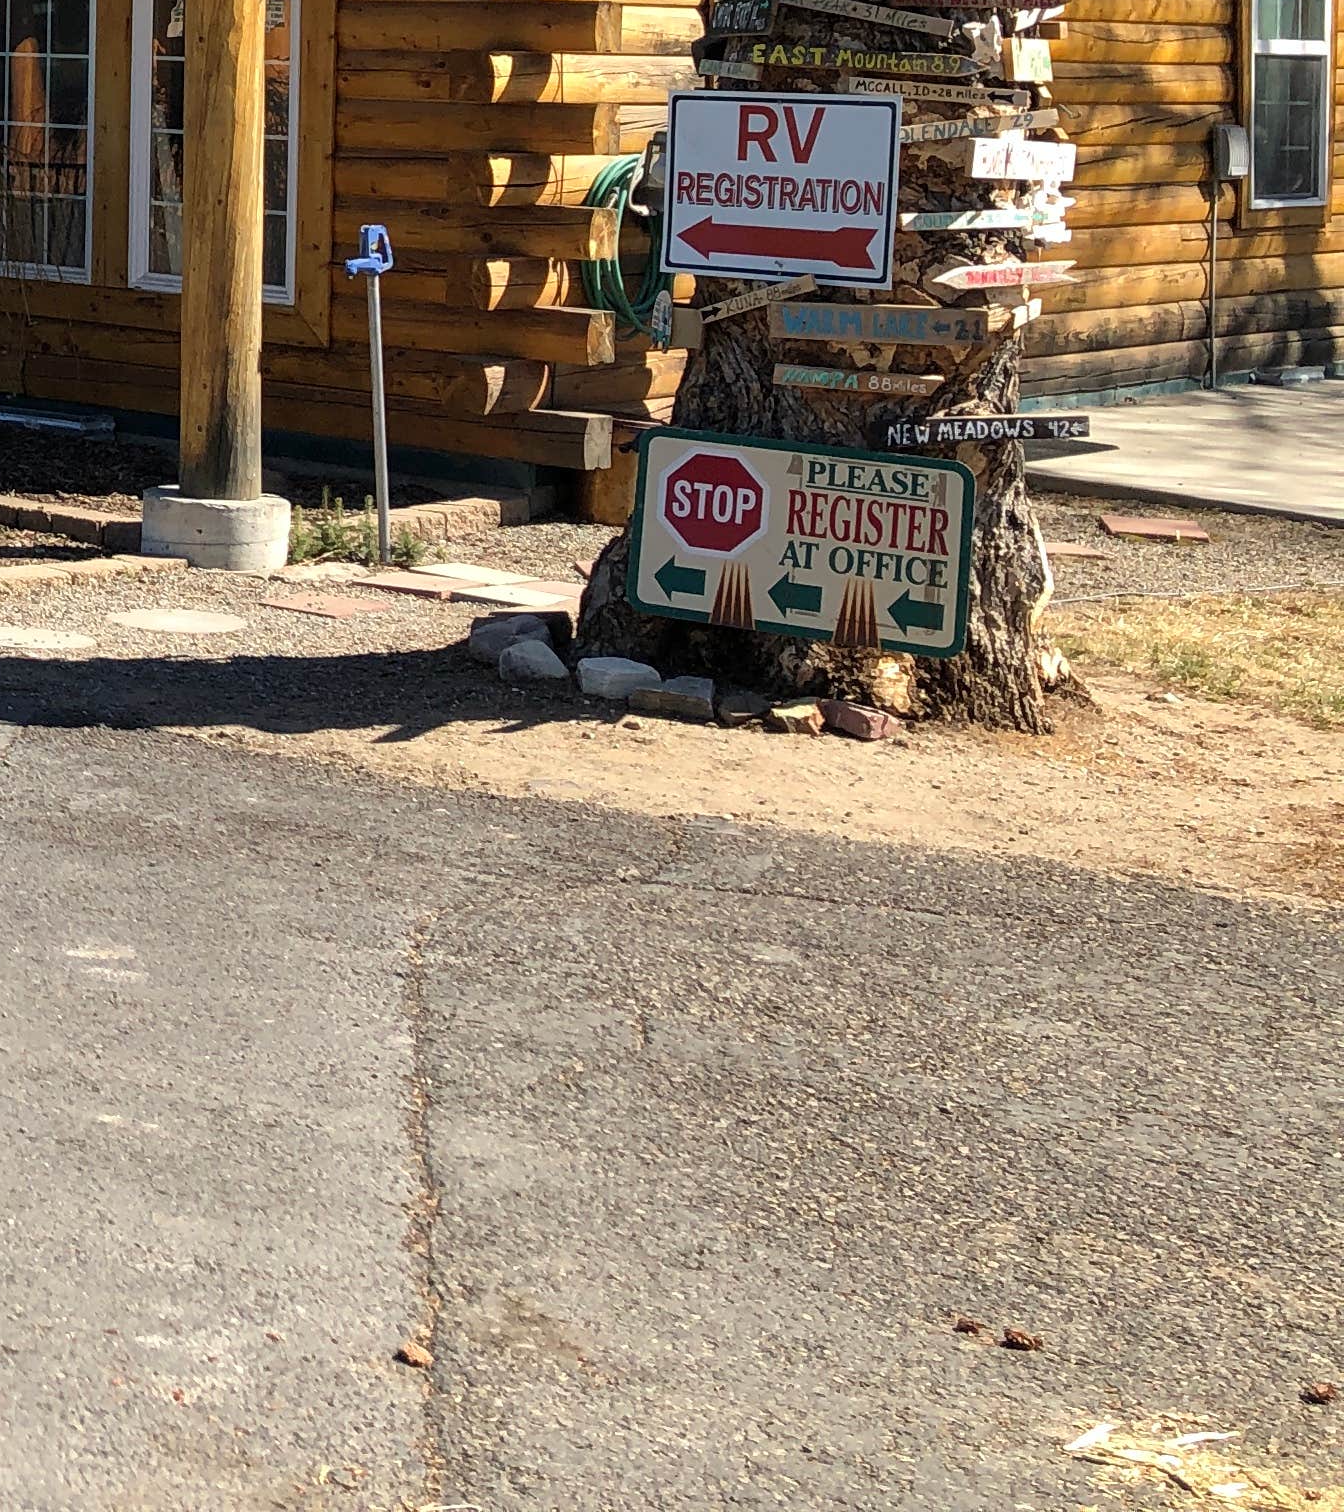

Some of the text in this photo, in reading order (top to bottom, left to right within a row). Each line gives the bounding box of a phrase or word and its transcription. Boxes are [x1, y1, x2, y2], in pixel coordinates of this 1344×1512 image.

[752, 44, 828, 66] EAST
[834, 48, 929, 74] Mountain
[735, 103, 827, 166] RV
[1011, 113, 1034, 129] 29
[675, 170, 885, 217] REGISTRATION
[872, 310, 930, 339] LAKE
[887, 418, 1071, 447] NEW MEADOWS 42
[806, 458, 931, 499] PLEASE
[671, 477, 757, 526] STOP
[785, 487, 950, 557] REGISTER
[777, 538, 949, 589] AT OFFICE
